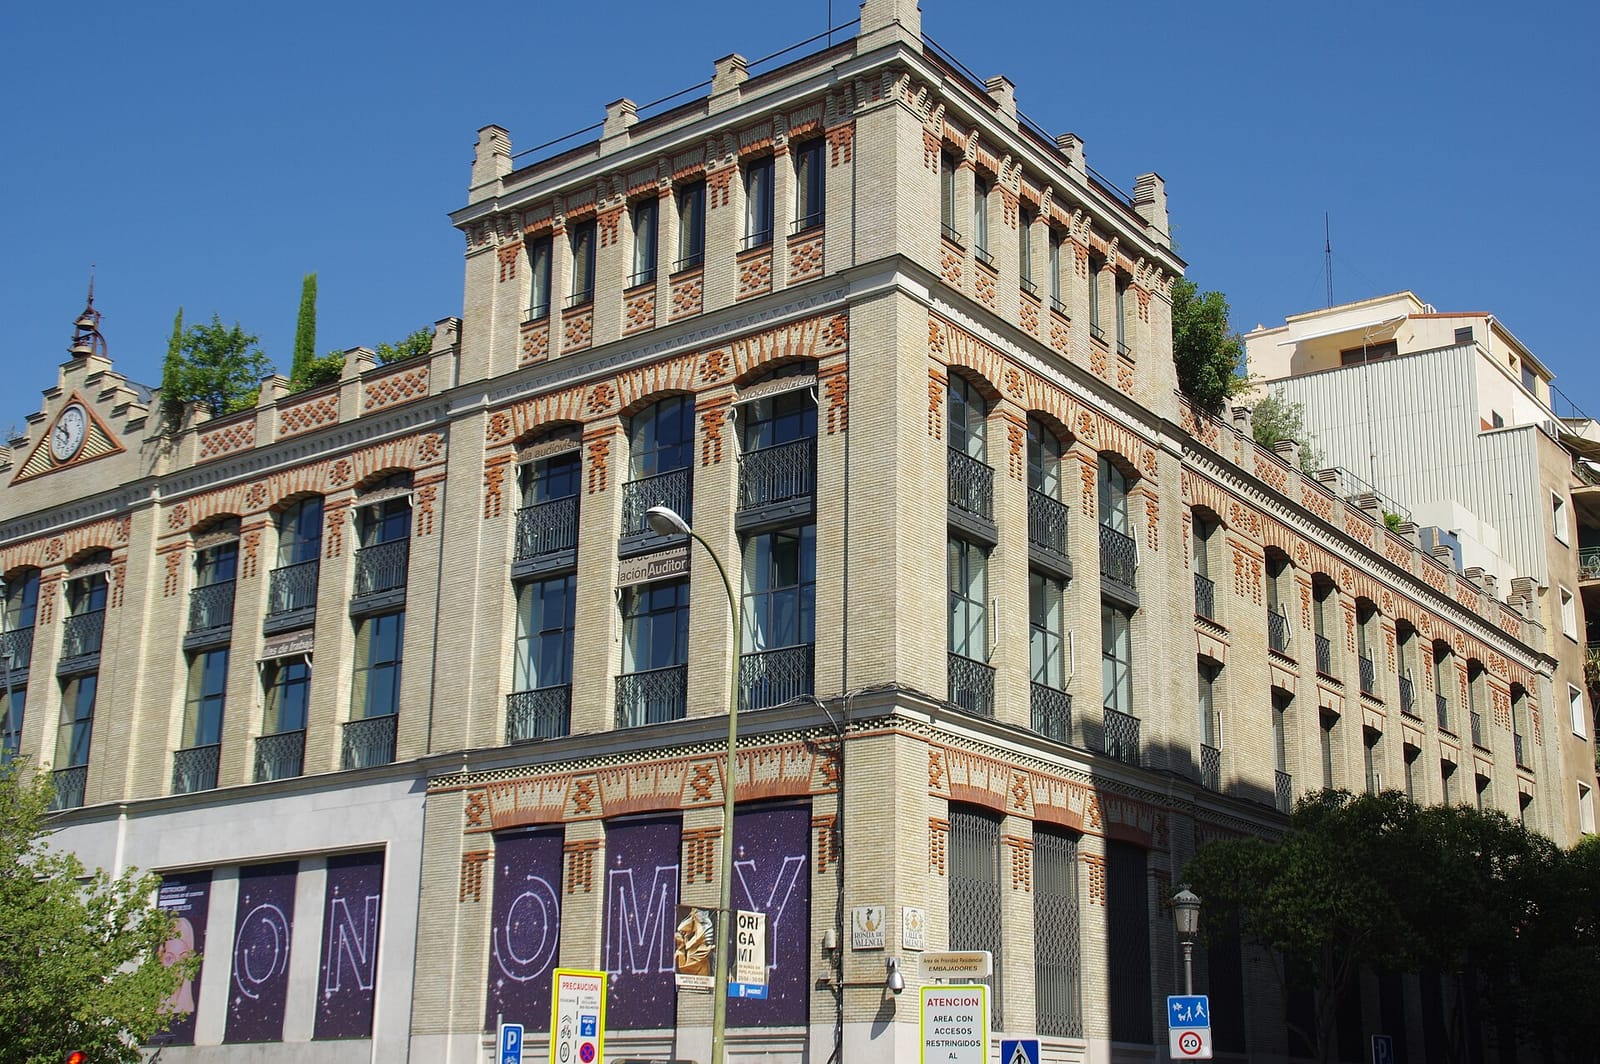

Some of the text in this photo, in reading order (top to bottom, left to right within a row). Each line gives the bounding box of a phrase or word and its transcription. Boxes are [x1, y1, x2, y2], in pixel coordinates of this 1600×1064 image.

[620, 566, 647, 582] ación
[738, 915, 759, 930] ORI
[738, 931, 756, 946] GA
[738, 948, 753, 963] MI
[562, 981, 599, 992] PRECAUCION
[927, 997, 979, 1007] ATENCION
[933, 1015, 974, 1023] AREA CON
[934, 1027, 973, 1036] ACCESOS
[507, 1031, 517, 1051] P
[925, 1039, 982, 1048] RESTRINGIDOS
[1183, 1039, 1198, 1049] 20
[948, 1051, 958, 1060] AL
